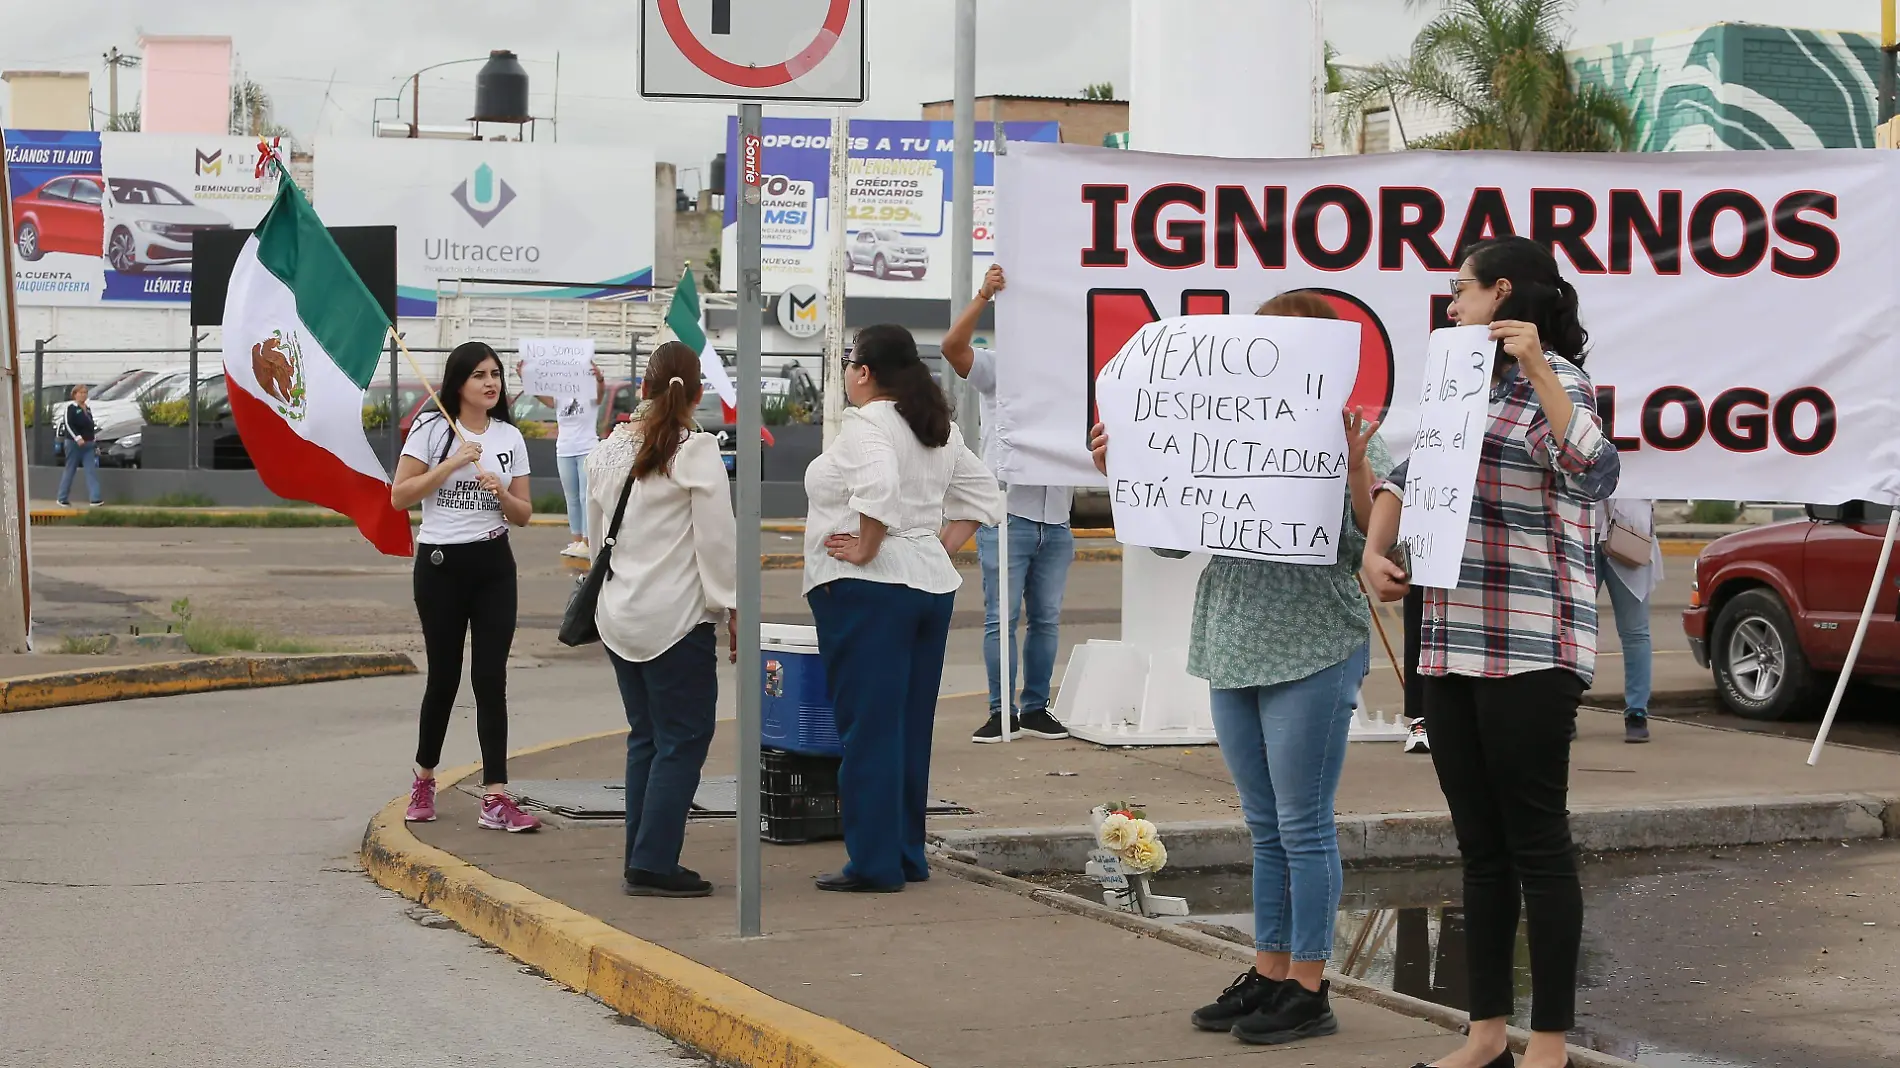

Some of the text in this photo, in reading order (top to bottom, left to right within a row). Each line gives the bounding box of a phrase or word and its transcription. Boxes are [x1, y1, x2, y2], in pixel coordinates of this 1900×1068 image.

[875, 137, 891, 151] A
[901, 138, 931, 152] TU
[52, 149, 65, 164] TU
[66, 150, 94, 165] AUTO
[194, 184, 262, 193] SEMINUEVOS
[856, 177, 919, 188] CRÉDITOS
[850, 188, 924, 198] BANCARIOS
[764, 210, 808, 225] MSI
[1081, 183, 1841, 280] IGNORARNOS
[424, 238, 540, 263] Ultracero
[26, 272, 72, 280] CUENTA
[58, 281, 90, 292] OFERTA
[143, 276, 181, 294] LLÉVATE
[1438, 349, 1458, 402] los
[1461, 351, 1485, 402] 3
[1452, 411, 1470, 451] el
[1148, 431, 1348, 477] LA DICTADURA
[438, 488, 471, 500] RESPETO
[473, 492, 479, 500] A
[1115, 476, 1256, 511] ESTÁ EN LA
[1424, 486, 1437, 512] NO
[1439, 486, 1459, 514] SE
[436, 497, 475, 510] DERECHOS
[1200, 511, 1330, 552] PUERTA
